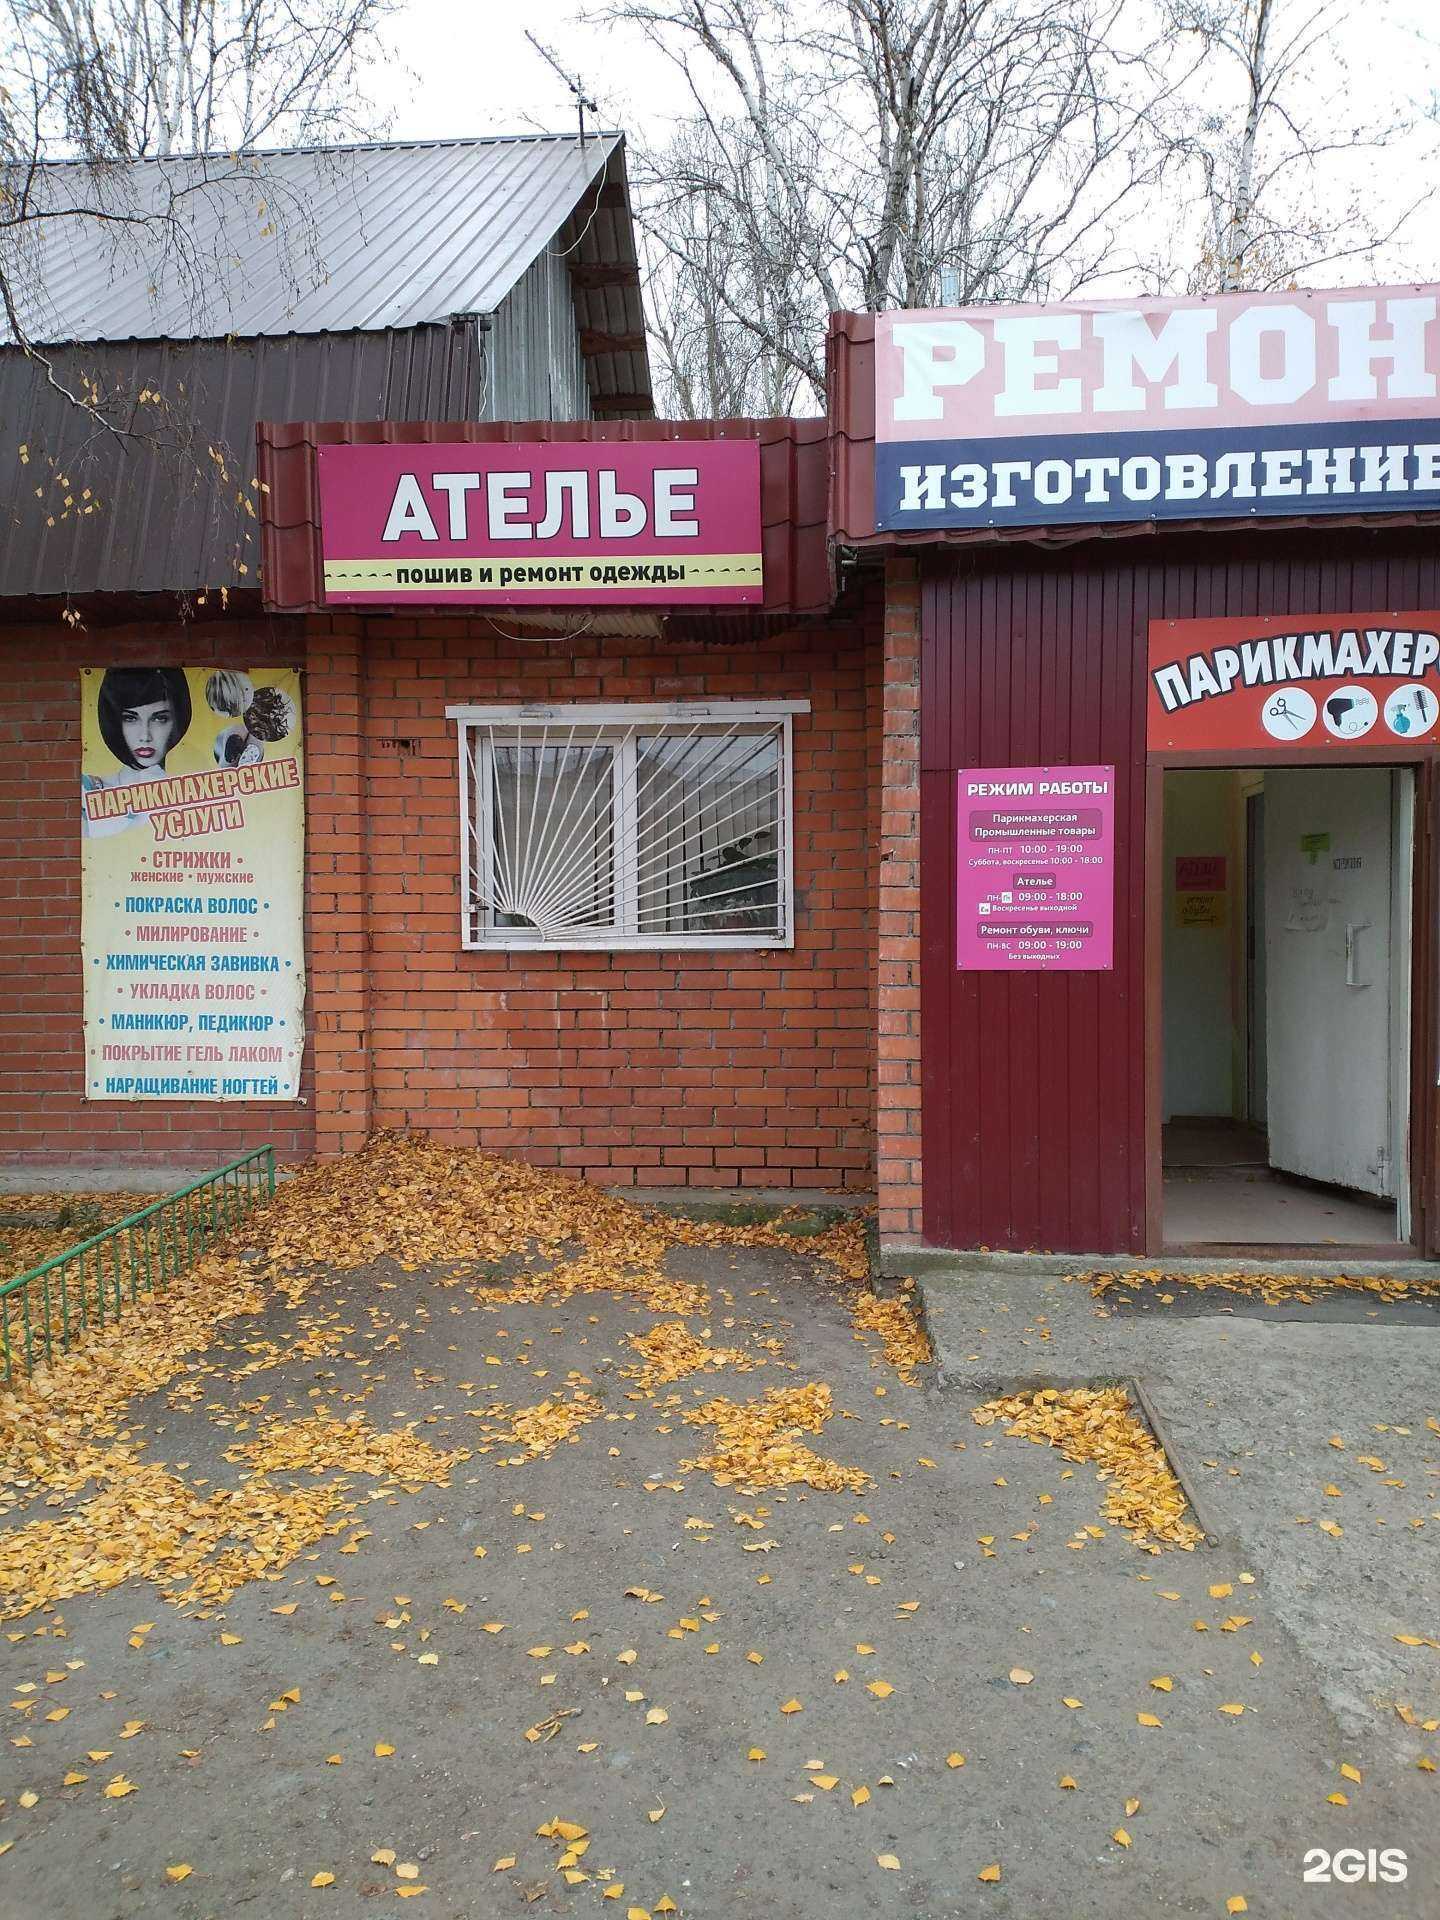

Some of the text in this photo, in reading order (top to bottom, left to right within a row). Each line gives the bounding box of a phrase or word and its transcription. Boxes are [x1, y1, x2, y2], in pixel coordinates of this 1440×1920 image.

[892, 296, 1437, 421] РЕМОН
[900, 443, 1440, 511] ИЗГОТОВЛЕНИЕ
[381, 468, 699, 542] АТЕЛЬЕ
[396, 563, 686, 587] пошив и ремонт одежды
[1153, 629, 1440, 712] ПАРИКМАХЕР
[86, 758, 300, 820] ПАРИКМАХЕРСКИЕ
[967, 782, 1108, 796] РЕЖИМ РАБОТЫ
[150, 800, 244, 841] УСЛУГИ
[993, 814, 1077, 825] Парикмахерская
[975, 827, 1095, 838] Промышленные товары
[1020, 845, 1047, 853] 10:00
[1055, 845, 1083, 853] 19:00
[153, 851, 231, 869] СТРИЖКИ
[1050, 857, 1073, 865] 10:00
[1081, 856, 1103, 864] 18:00
[130, 871, 253, 885] женские мужские
[1017, 877, 1053, 886] Ателье
[125, 897, 258, 914] ПОКРАСКА ВОЛОС
[1018, 893, 1047, 901] 09:00
[1055, 893, 1083, 901] 18:00
[136, 926, 248, 943] МИЛИРОВАНИЕ
[981, 926, 1089, 936] Ремонт обуви, ключи
[1018, 941, 1047, 949] 09:00
[1055, 941, 1082, 949] 19:00
[106, 954, 280, 972] ХИМИЧЕСКАЯ ЗАВИВКА
[130, 984, 255, 1001] УКЛАДКА ВОЛОС
[111, 1014, 273, 1033] МАНИКЮР, ПЕДИКЮР
[102, 1045, 283, 1063] ПОКРЫТИЕ ГЕЛЬ ЛАКОМ
[106, 1075, 278, 1096] НАРАЩИВАНИЕ НОГТЕЙ
